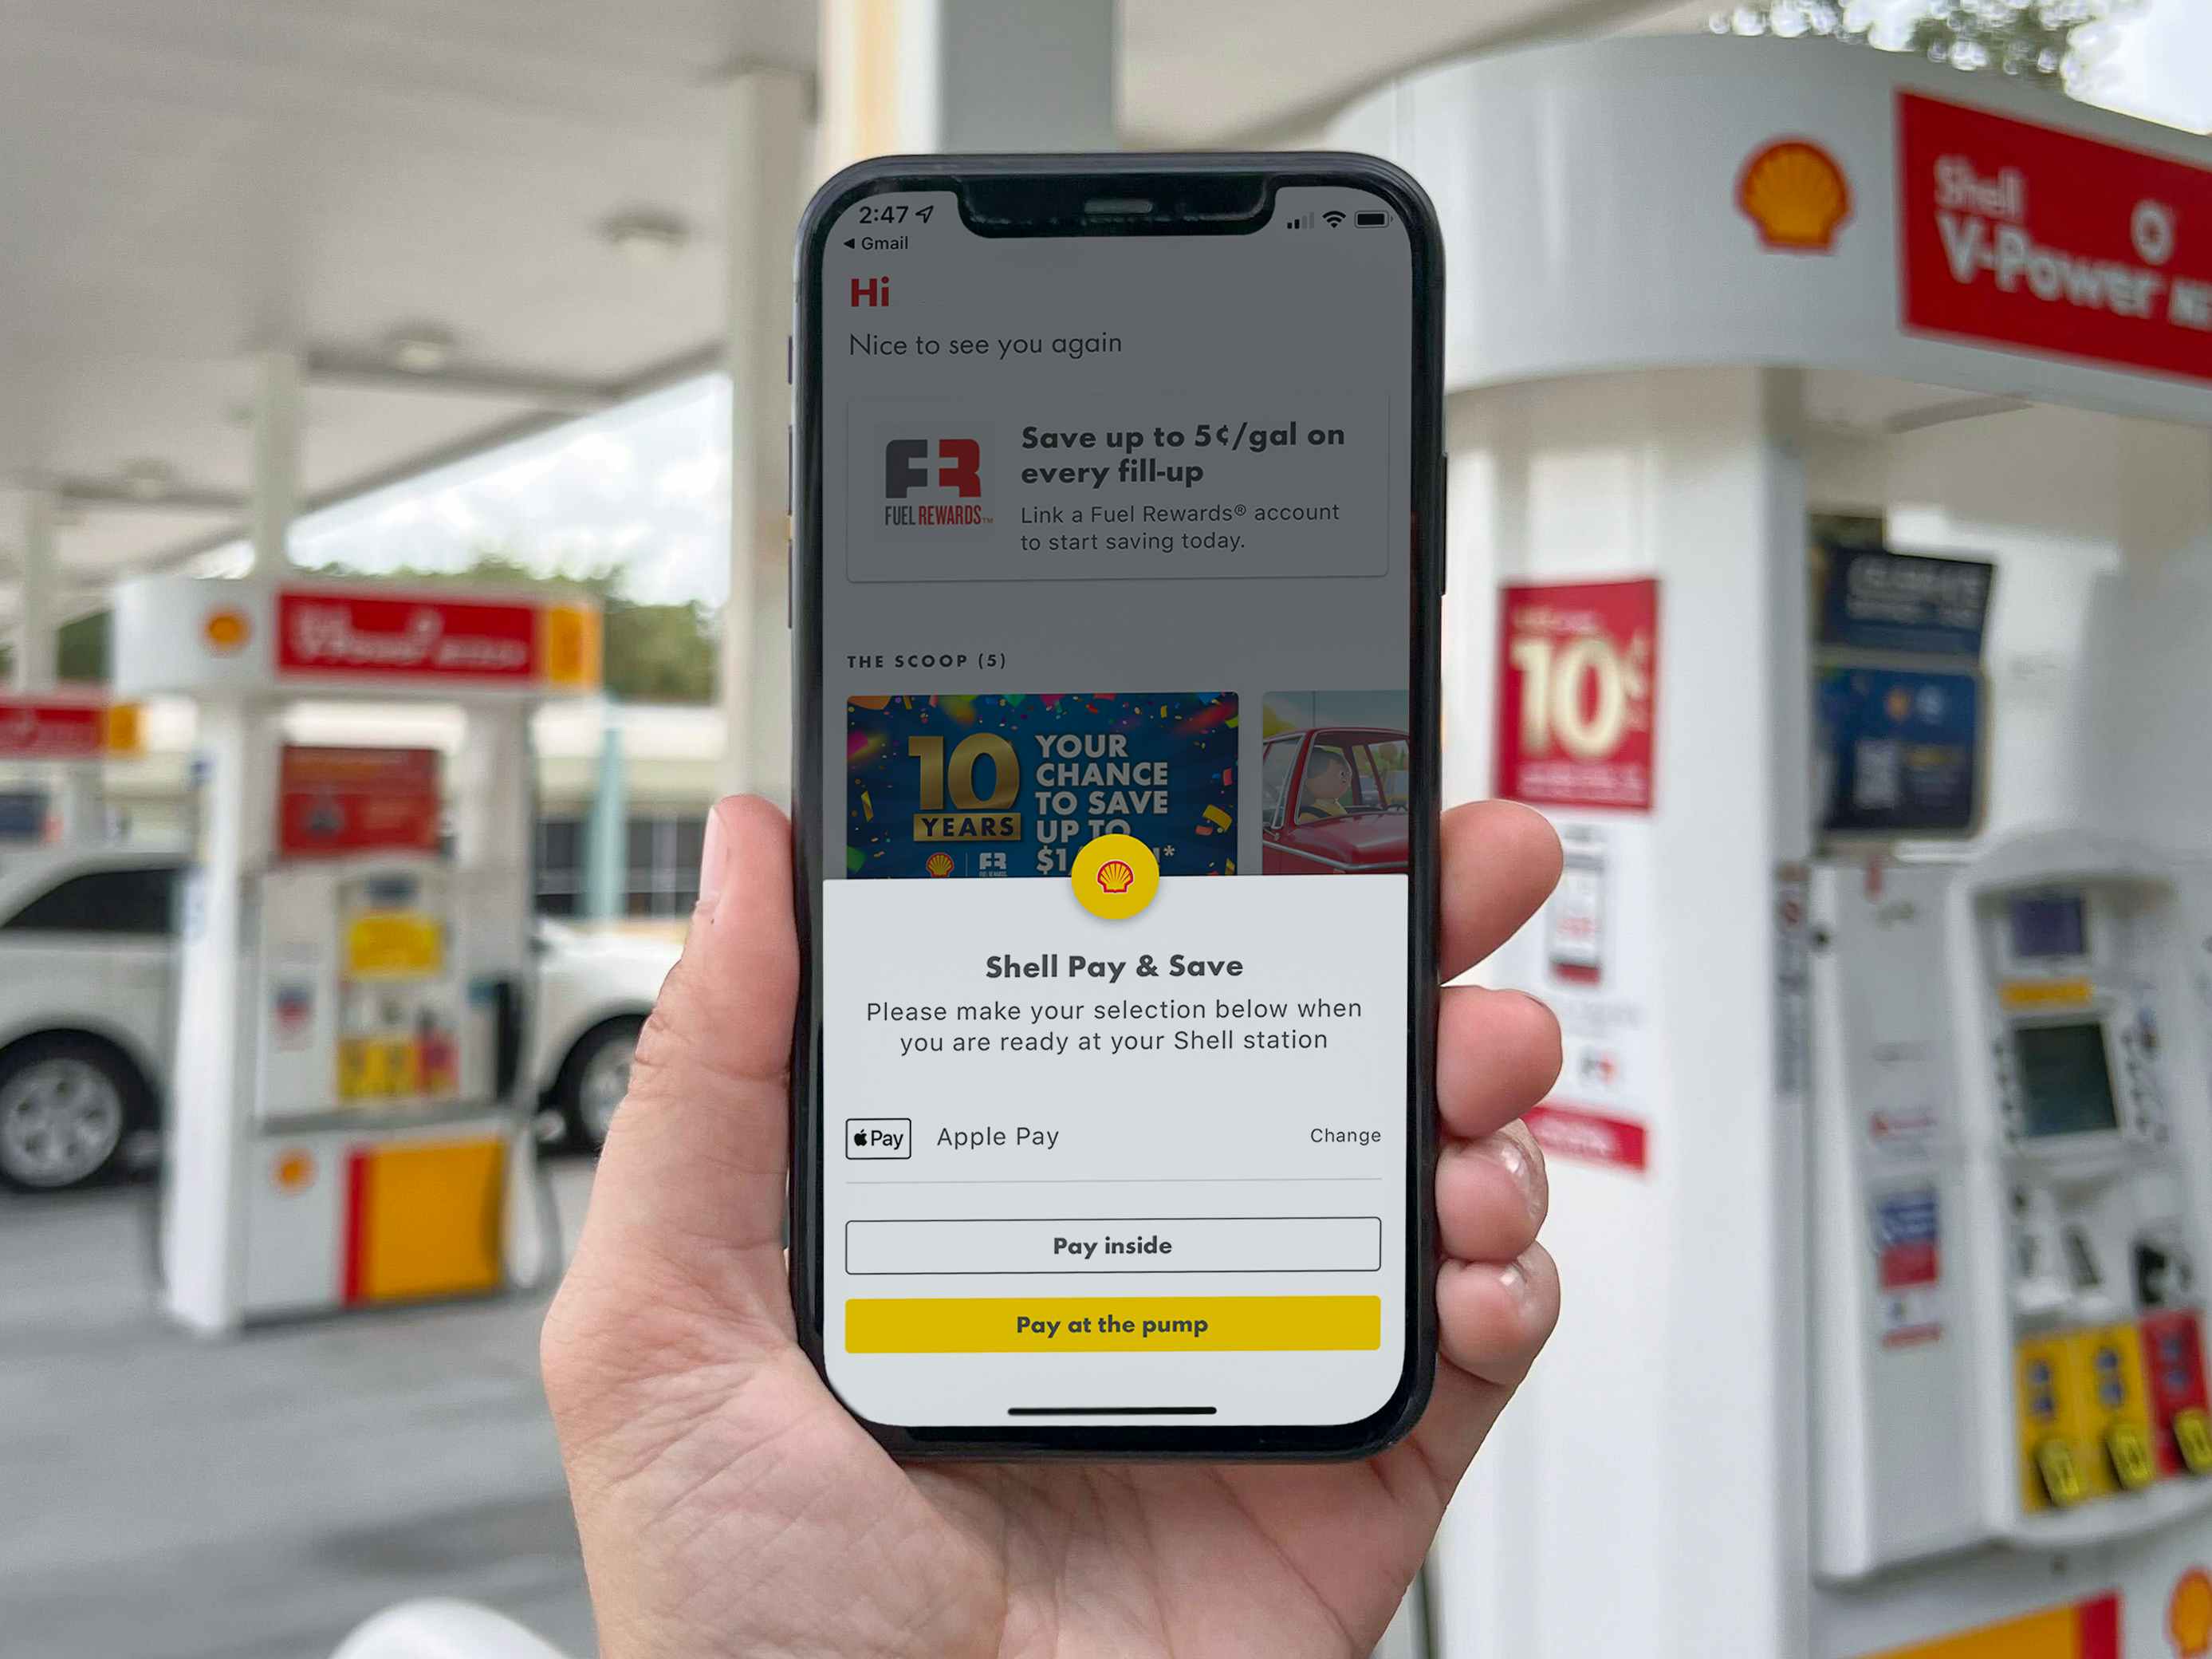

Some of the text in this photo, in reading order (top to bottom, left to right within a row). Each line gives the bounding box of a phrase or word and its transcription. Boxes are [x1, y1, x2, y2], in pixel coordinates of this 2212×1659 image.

[1935, 156, 2027, 223] Shell
[859, 205, 908, 224] 2:47
[862, 236, 908, 250] Gmail
[1935, 211, 2167, 319] V-Power
[851, 276, 890, 307] Hi
[850, 332, 1122, 360] Nice to see you again
[1021, 421, 1344, 454] Save up to 5¢/gal on
[1021, 458, 1204, 490] every fill-up
[885, 506, 915, 525] FUEL
[1021, 505, 1064, 524] Link
[1071, 510, 1084, 523] a
[1091, 505, 1135, 524] Fuel
[1254, 504, 1340, 522] account
[1021, 531, 1245, 553] to start saving today.
[847, 652, 1006, 670] THE SCOOP (5)
[1035, 734, 1128, 759] YOUR
[908, 731, 1020, 811] 10
[1035, 762, 1169, 787] CHANCE
[1035, 790, 1169, 816] TO SAVE
[921, 815, 1014, 838] YEARS
[1037, 819, 1079, 844] UP
[986, 953, 1244, 984] Shell Pay & Save
[867, 997, 1362, 1025] Please make your selection below when
[899, 1028, 1328, 1057] you are ready at your Shell station
[872, 1129, 904, 1150] Pay
[937, 1125, 1060, 1151] Apple Pay
[1310, 1127, 1382, 1146] Change
[1053, 1235, 1173, 1259] Pay inside
[1016, 1314, 1211, 1340] Pay at the pump
